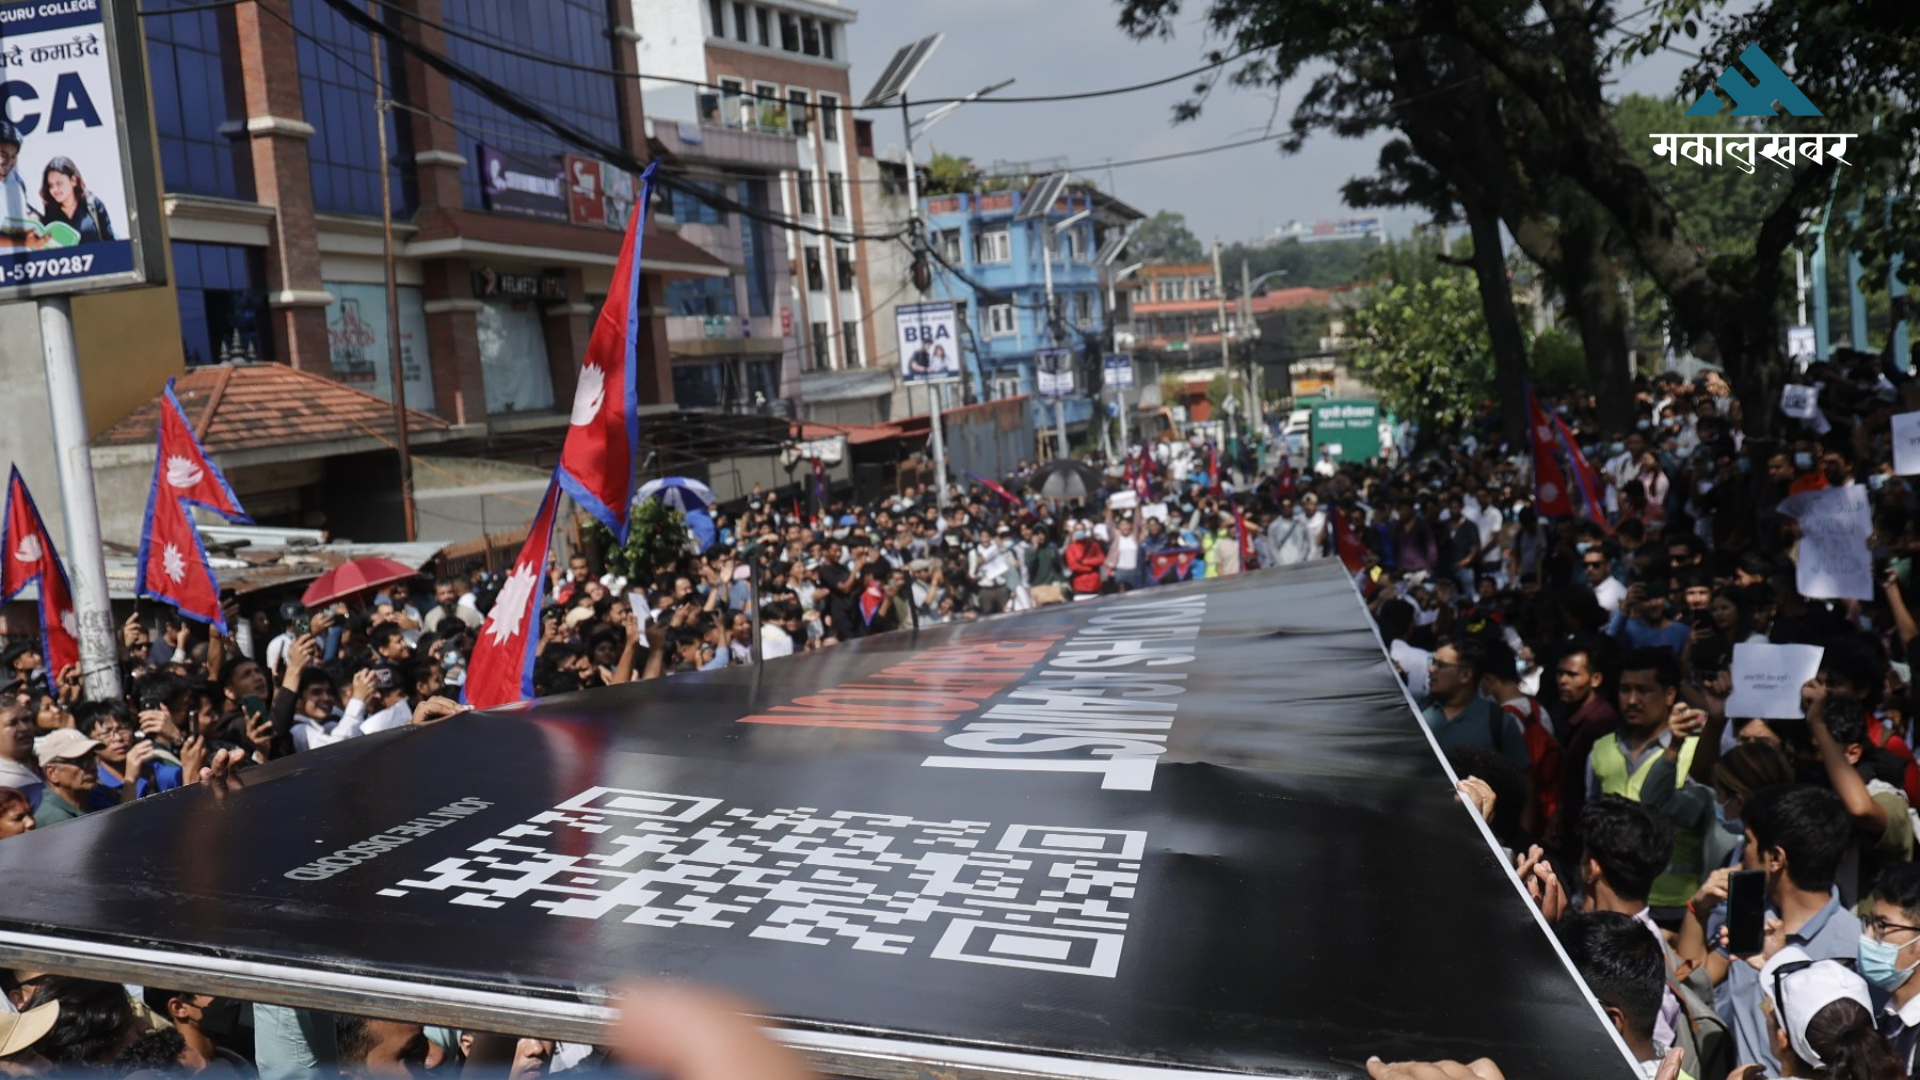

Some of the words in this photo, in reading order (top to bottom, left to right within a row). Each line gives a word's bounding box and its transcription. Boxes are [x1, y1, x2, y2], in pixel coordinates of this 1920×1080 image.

[0, 6, 35, 23] GURU
[38, 0, 97, 17] COLLEGE
[29, 33, 98, 63] कमाउँदै
[904, 324, 950, 342] BBA
[1048, 594, 1208, 668] YOUTHS
[920, 671, 1188, 791] AGAINST
[428, 797, 495, 819] JOIN
[385, 818, 457, 837] THE
[284, 834, 414, 881] DISCORD
